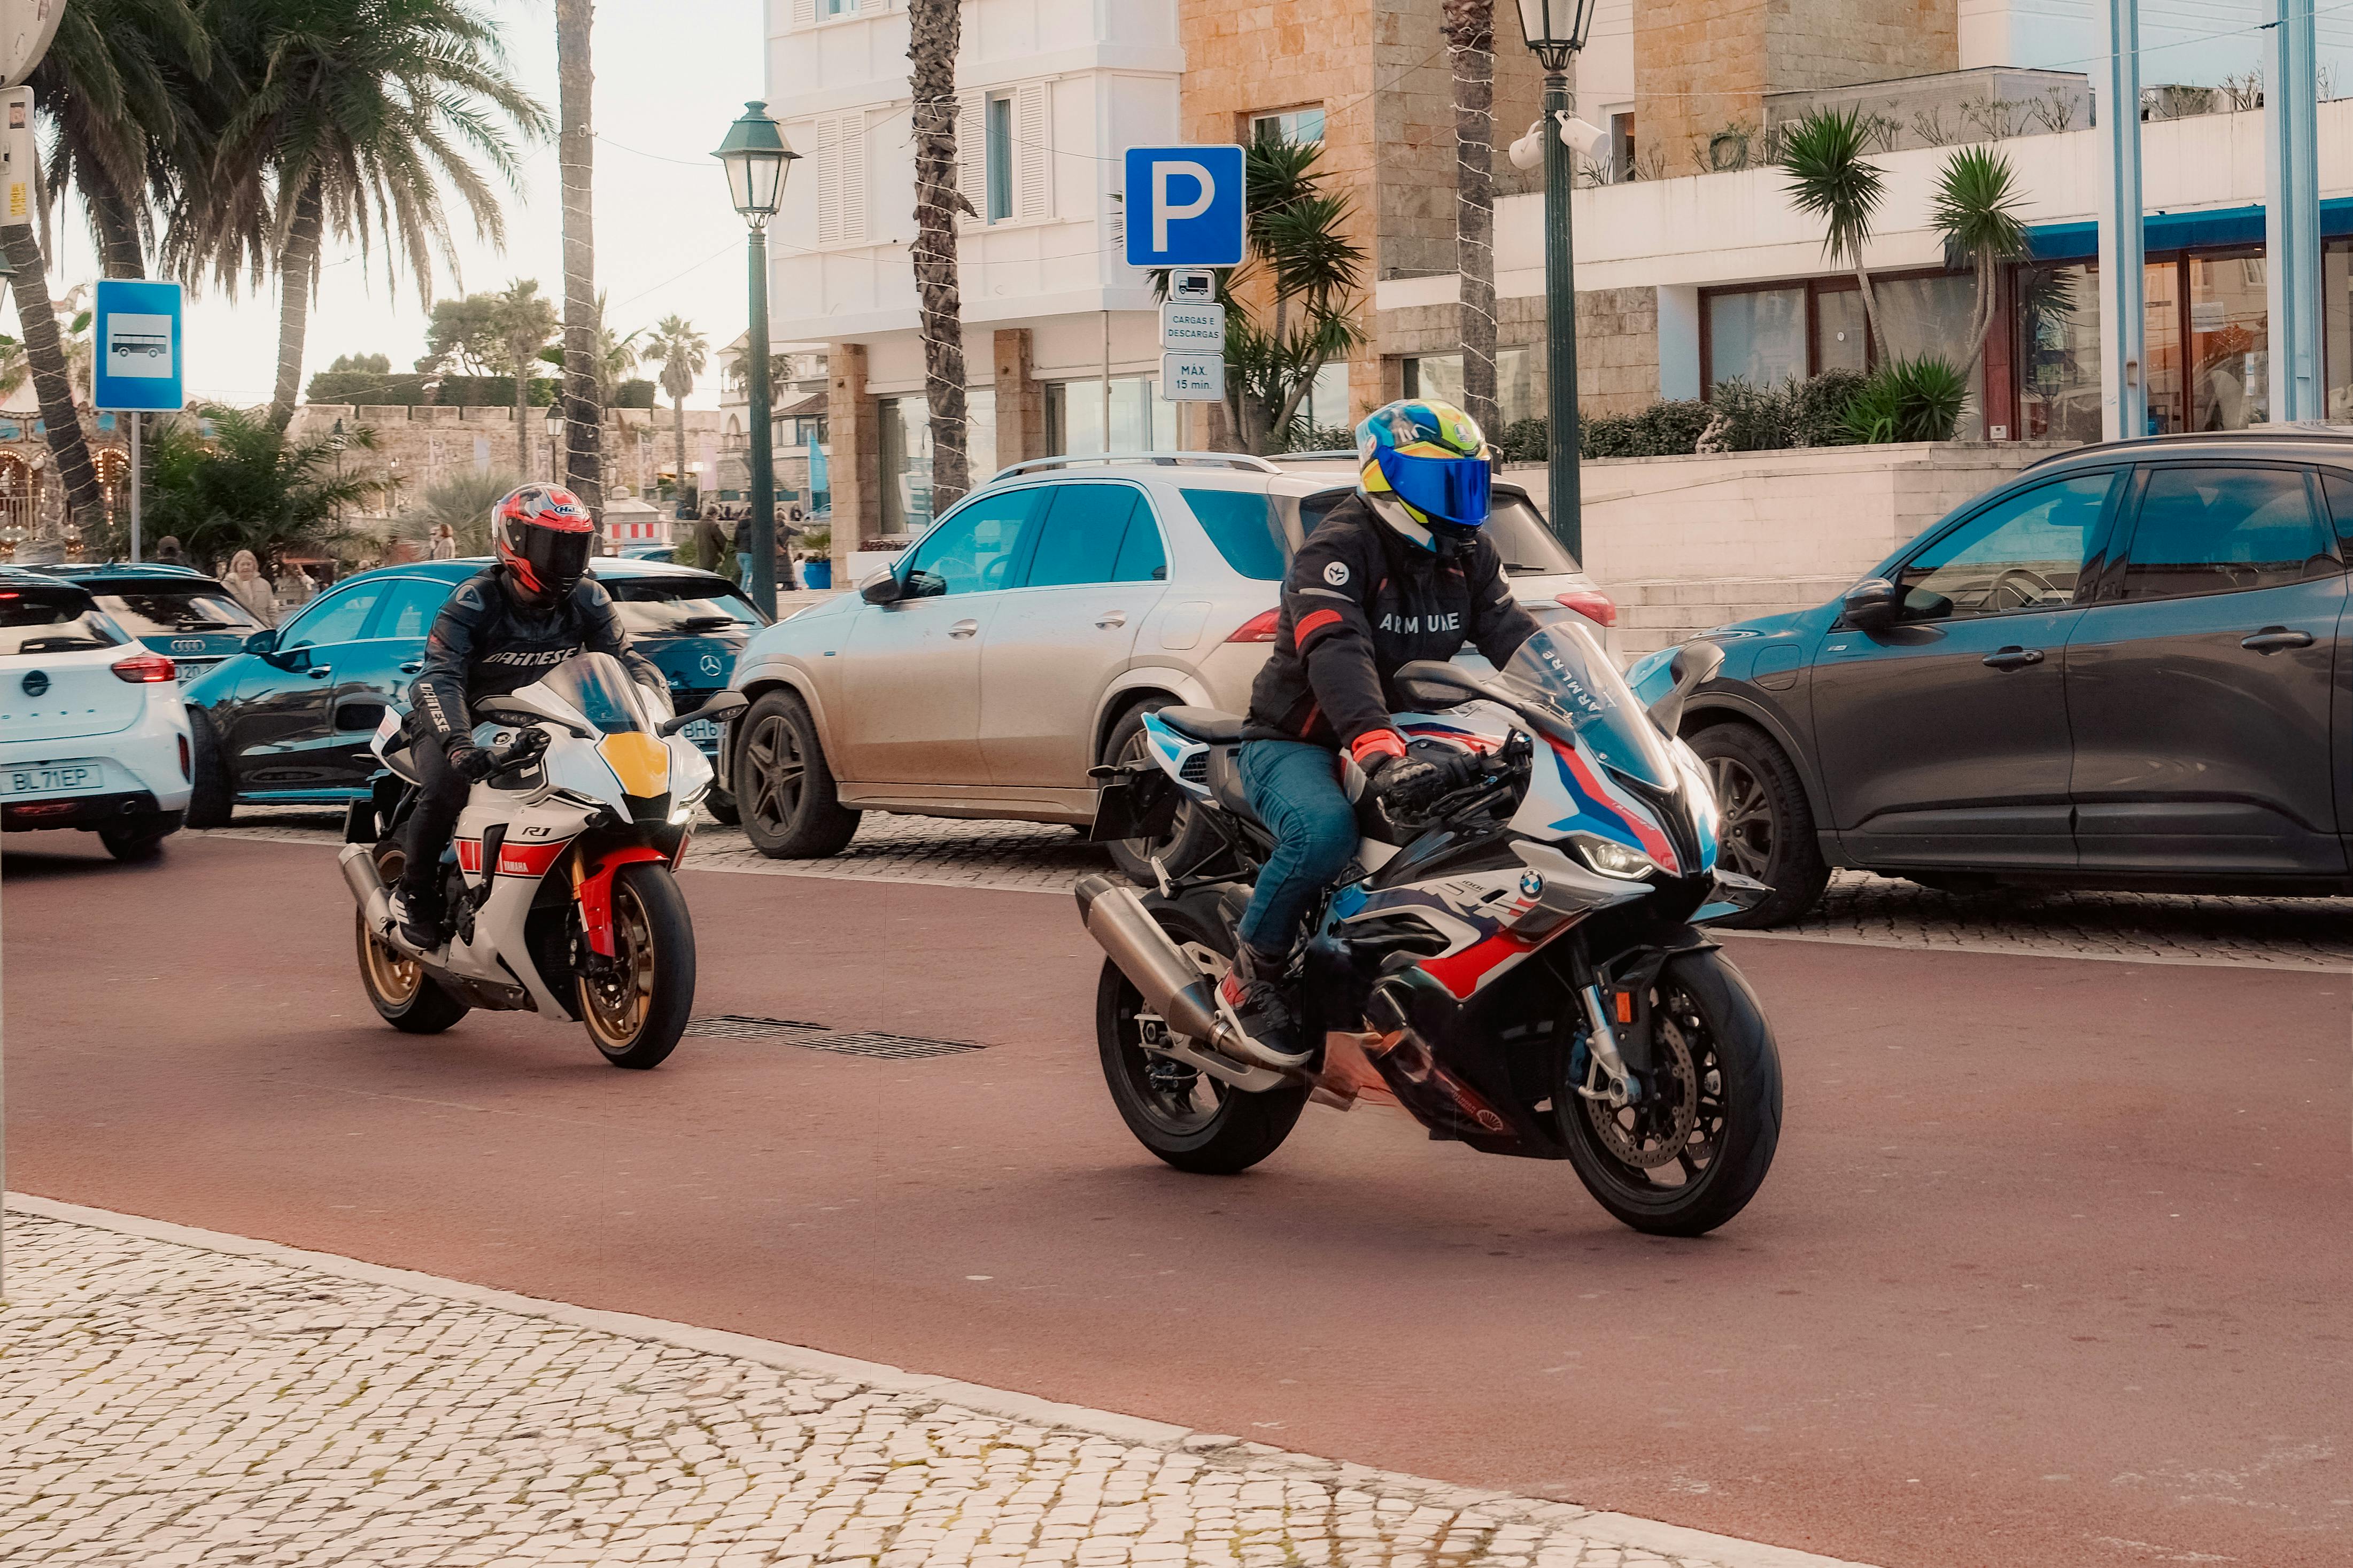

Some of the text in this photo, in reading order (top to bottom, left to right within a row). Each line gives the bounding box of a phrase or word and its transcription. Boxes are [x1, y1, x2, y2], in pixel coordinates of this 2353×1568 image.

[1152, 161, 1216, 252] P
[1173, 316, 1207, 324] CARGAS
[1168, 329, 1219, 338] DESCARGAS
[1176, 379, 1213, 390] 15 min.
[419, 683, 451, 733] DAINESE
[522, 826, 552, 836] R1
